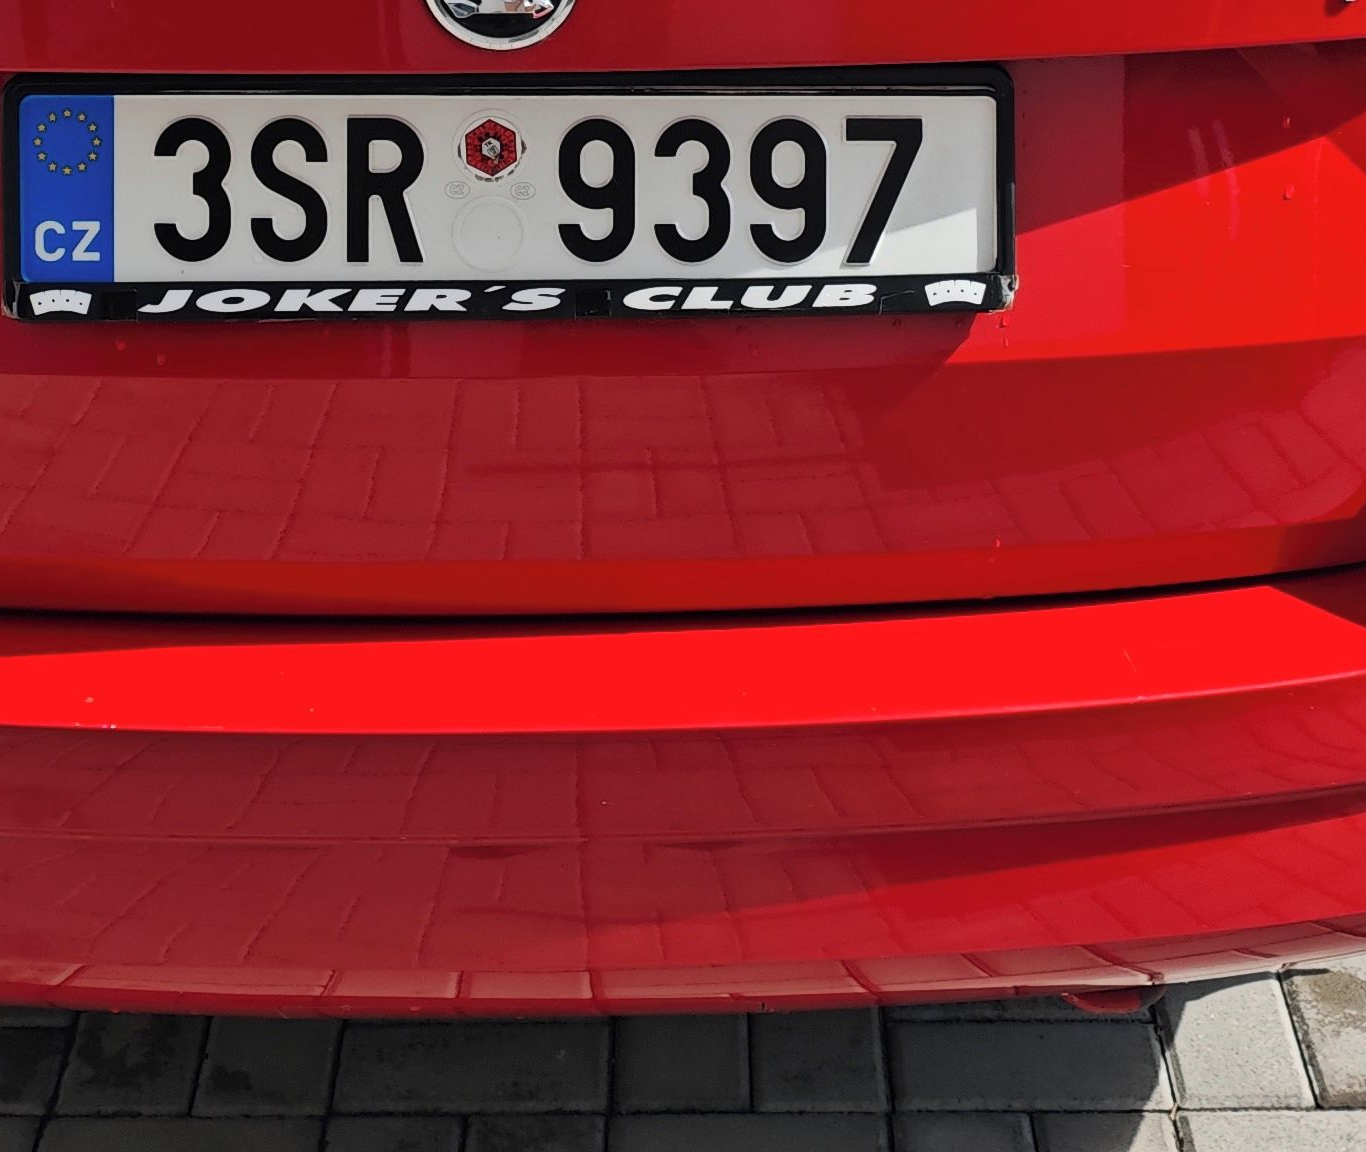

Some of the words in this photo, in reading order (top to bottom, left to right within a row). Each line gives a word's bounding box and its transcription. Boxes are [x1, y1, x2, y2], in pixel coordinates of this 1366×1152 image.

[152, 115, 426, 265] 3SR
[556, 115, 925, 268] 9397
[34, 219, 101, 264] CZ
[621, 283, 878, 311] CLUB
